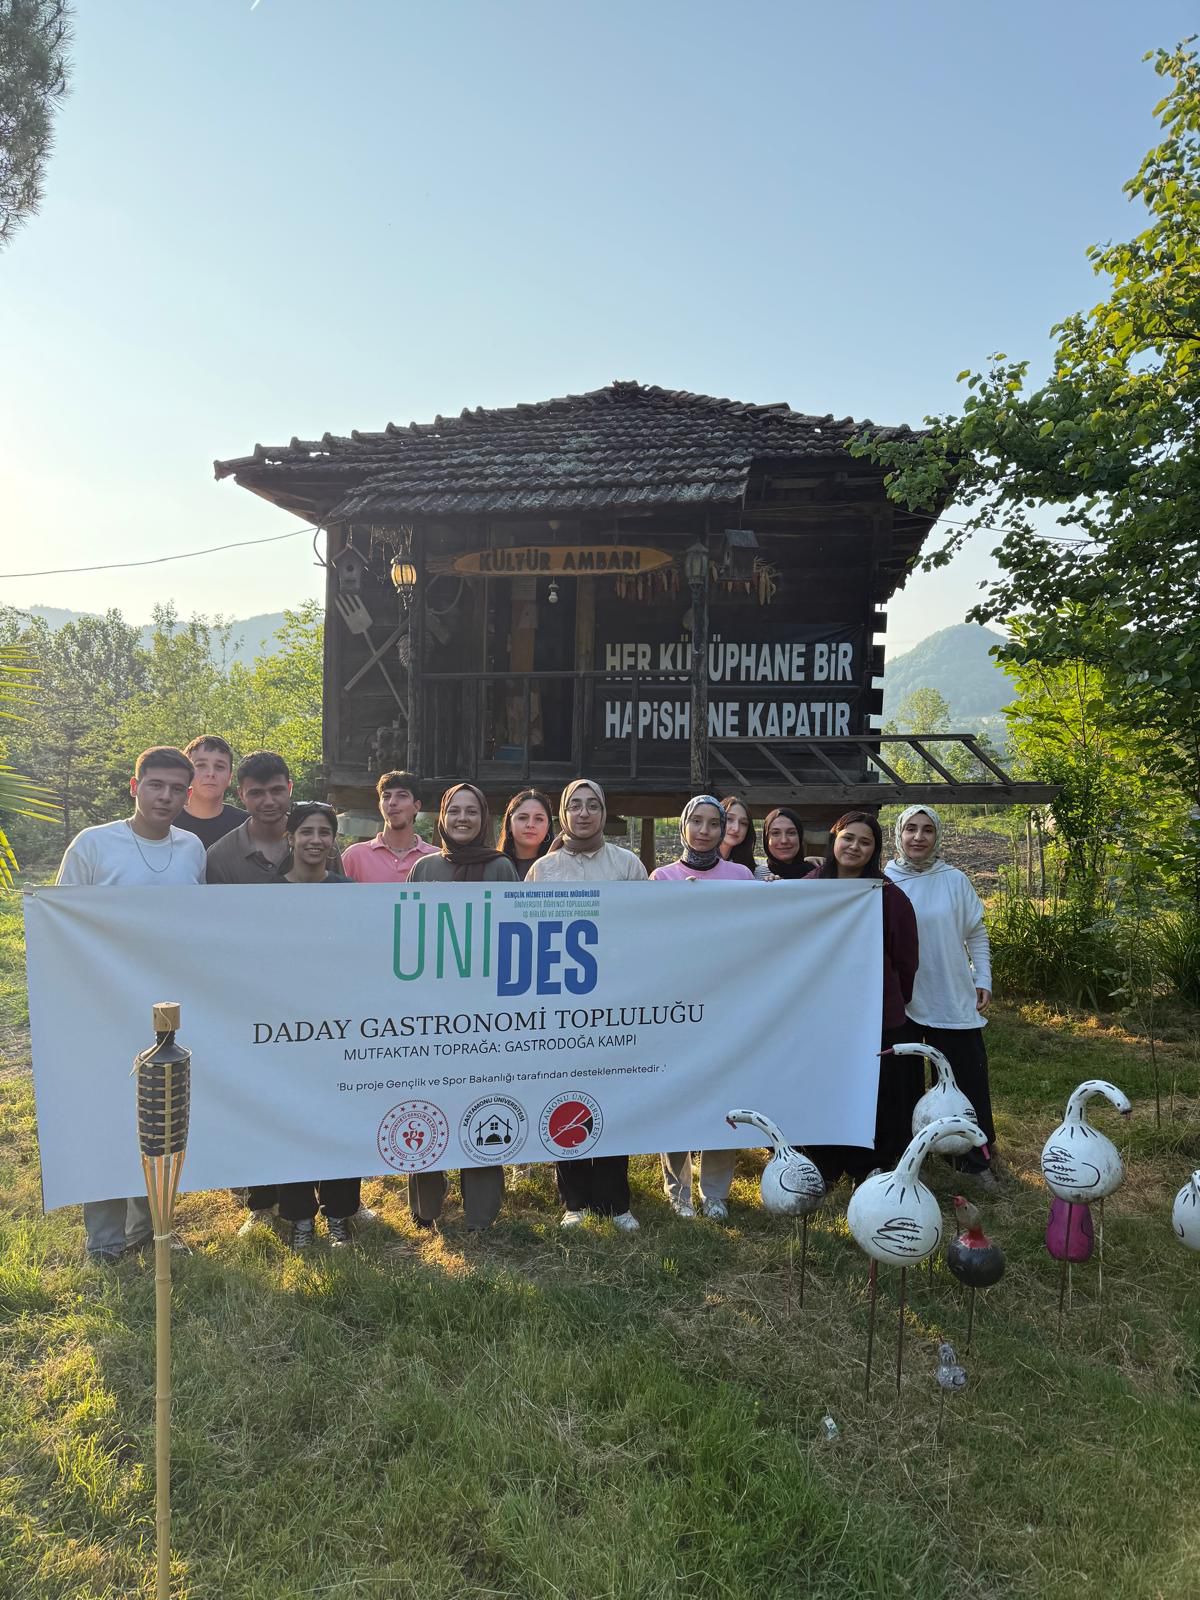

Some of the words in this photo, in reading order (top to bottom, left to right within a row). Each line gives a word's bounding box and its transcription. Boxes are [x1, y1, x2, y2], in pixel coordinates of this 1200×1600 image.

[479, 549, 551, 571] KÜLTÜR
[562, 551, 641, 570] AMBARI
[605, 643, 652, 681] HER
[659, 634, 806, 681] KÜÜPHANE
[748, 702, 850, 737] KAPATIR
[554, 890, 569, 898] GENEL
[252, 1019, 352, 1044] DADAY
[360, 1006, 546, 1038] GASTRONOMİ
[554, 1000, 704, 1029] TOPLULUĞU
[344, 1045, 430, 1061] MUTFAKTAN
[433, 1039, 501, 1056] TOPRAĞA:
[505, 1034, 595, 1052] GASTRODOĞA
[598, 1034, 637, 1047] KAMPI
[356, 1080, 384, 1092] proje
[386, 1077, 426, 1089] Gençlik
[428, 1078, 440, 1086] ve
[442, 1076, 466, 1087] Spor
[469, 1072, 515, 1084] Bakanlığı
[517, 1069, 568, 1081] tarafından
[463, 1097, 493, 1127] KASTAMONU
